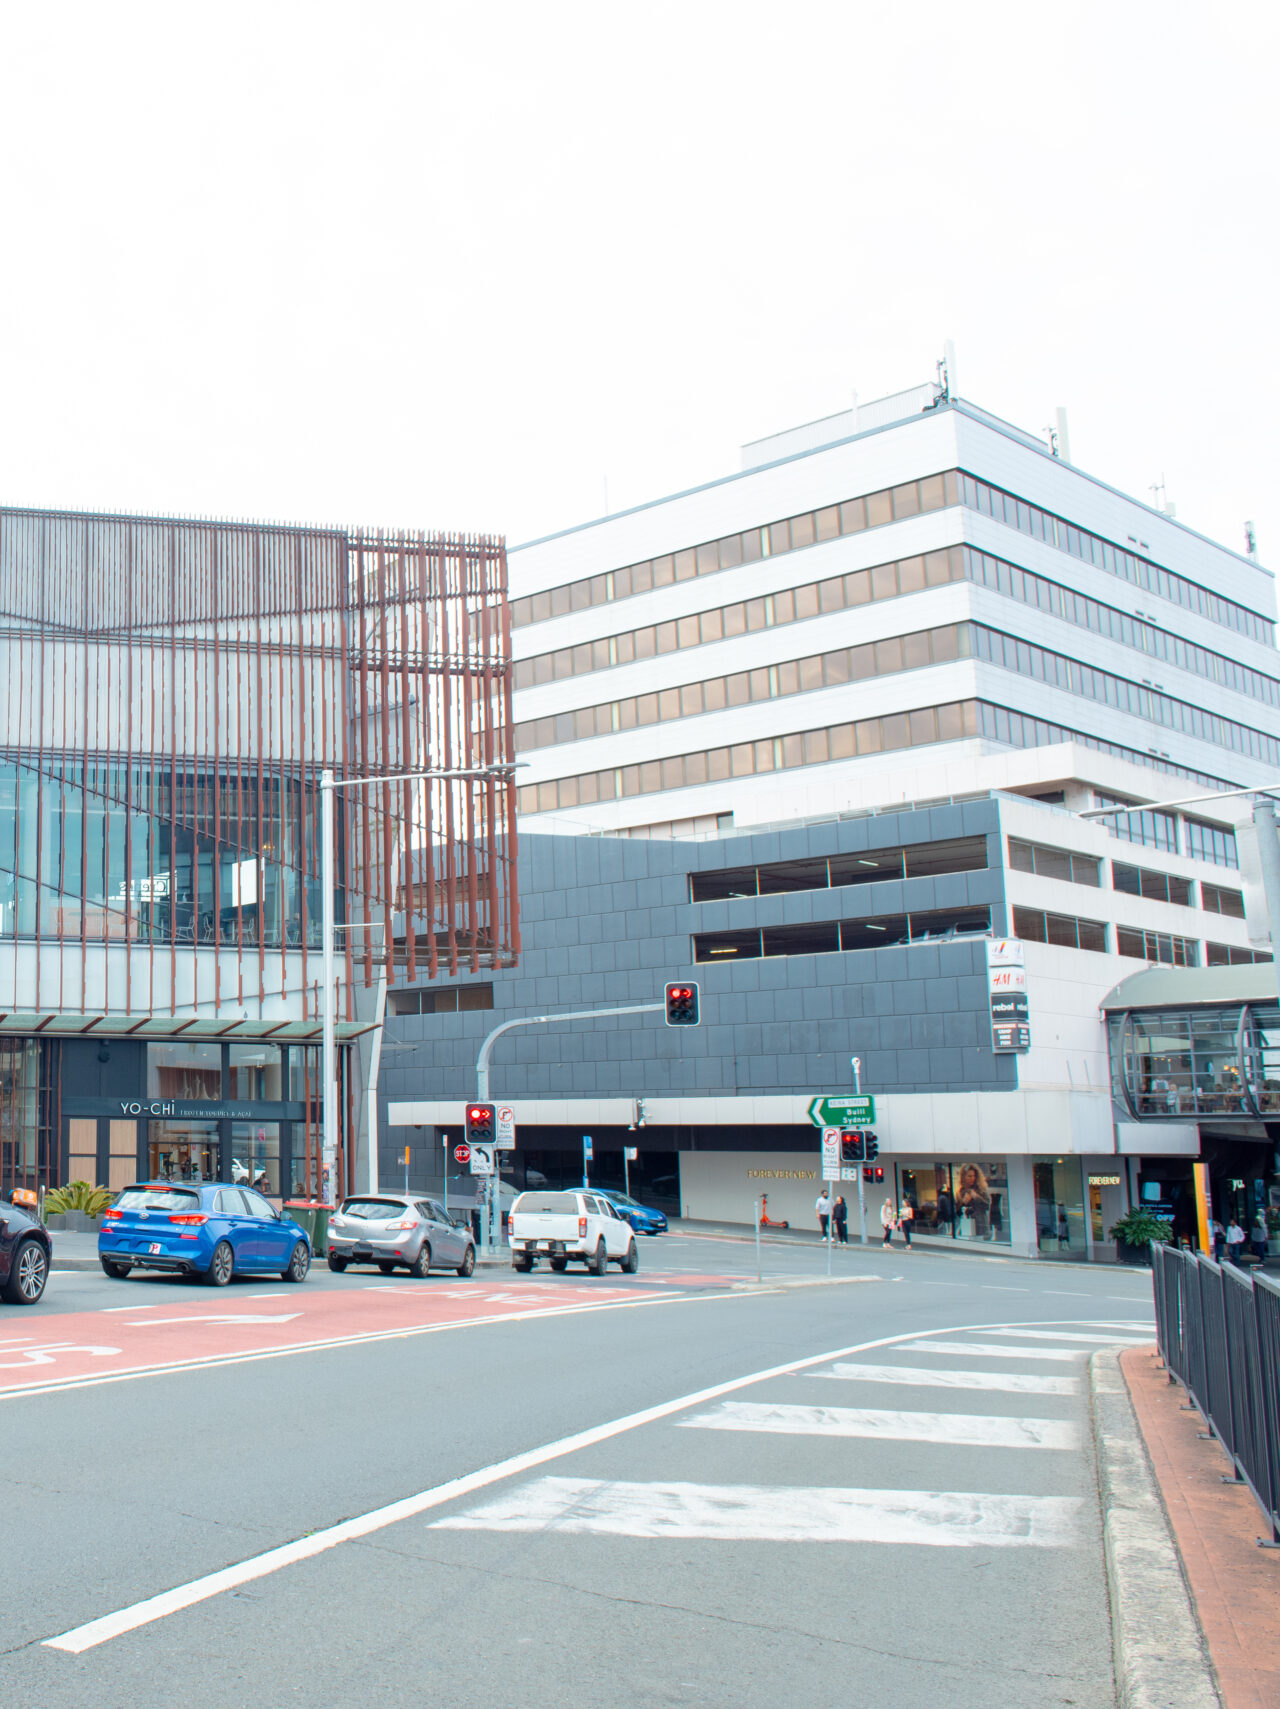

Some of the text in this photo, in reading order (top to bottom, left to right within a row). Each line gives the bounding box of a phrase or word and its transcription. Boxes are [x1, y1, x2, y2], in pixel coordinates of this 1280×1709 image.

[992, 1002, 1015, 1011] rebel
[842, 1116, 871, 1124] Sydney
[747, 1170, 790, 1179] FOREVER
[792, 1170, 816, 1179] NEW
[1110, 1176, 1121, 1185] NEW
